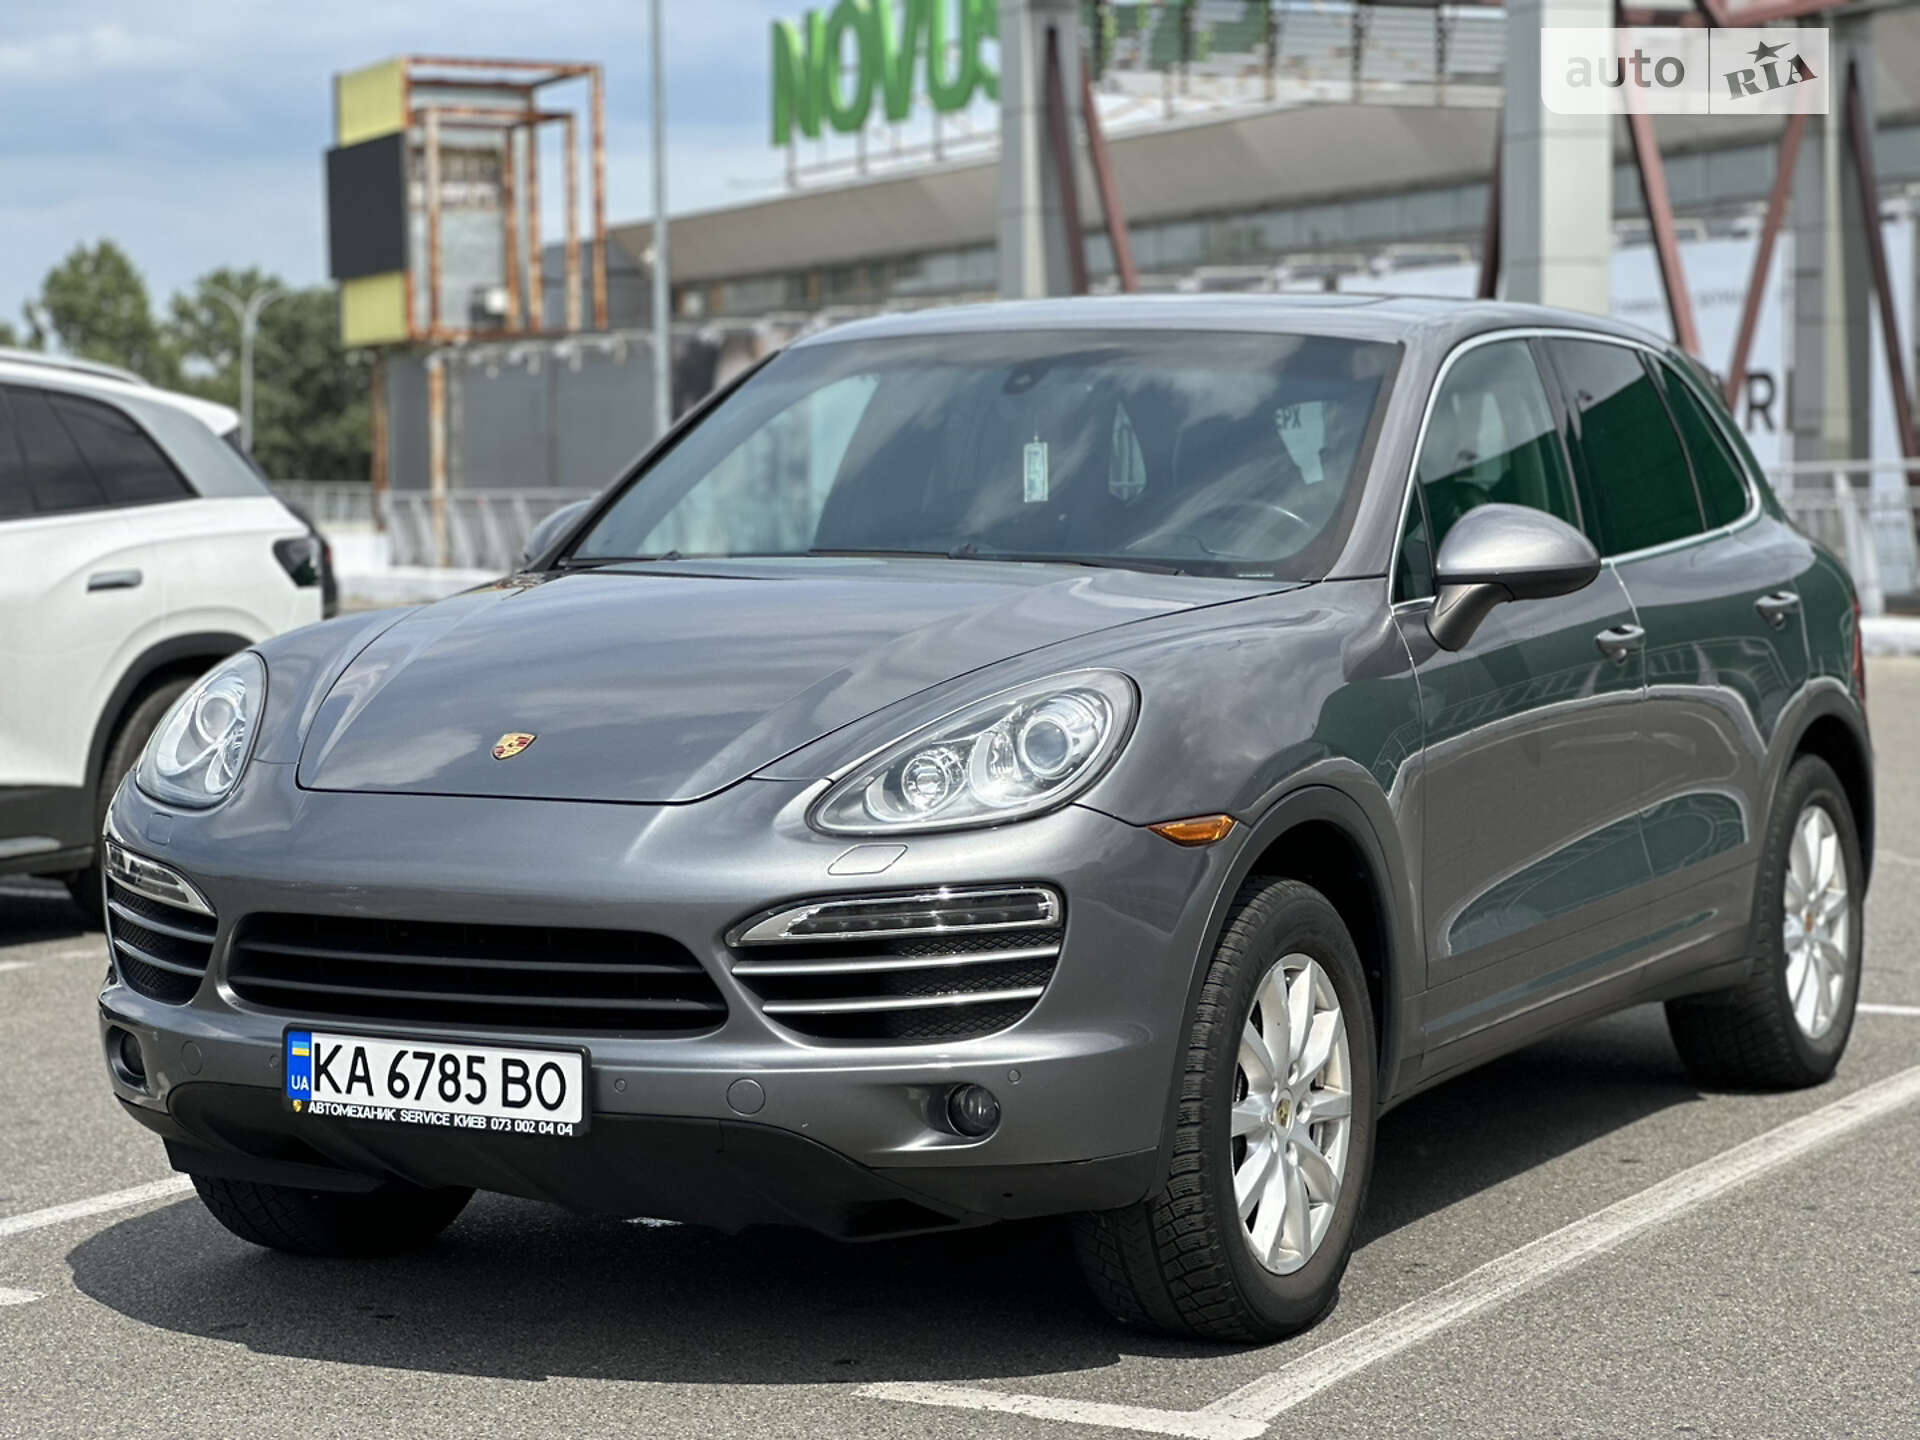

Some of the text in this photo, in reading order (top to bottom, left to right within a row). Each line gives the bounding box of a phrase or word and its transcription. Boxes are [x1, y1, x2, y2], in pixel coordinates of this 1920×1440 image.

[290, 1075, 310, 1091] UA
[314, 1043, 374, 1097] KA
[387, 1050, 487, 1105] 6785
[400, 1109, 450, 1126] SERVICE
[490, 1118, 511, 1131] 073
[514, 1120, 535, 1133] 002
[538, 1121, 554, 1135] 04
[557, 1123, 573, 1136] 04
